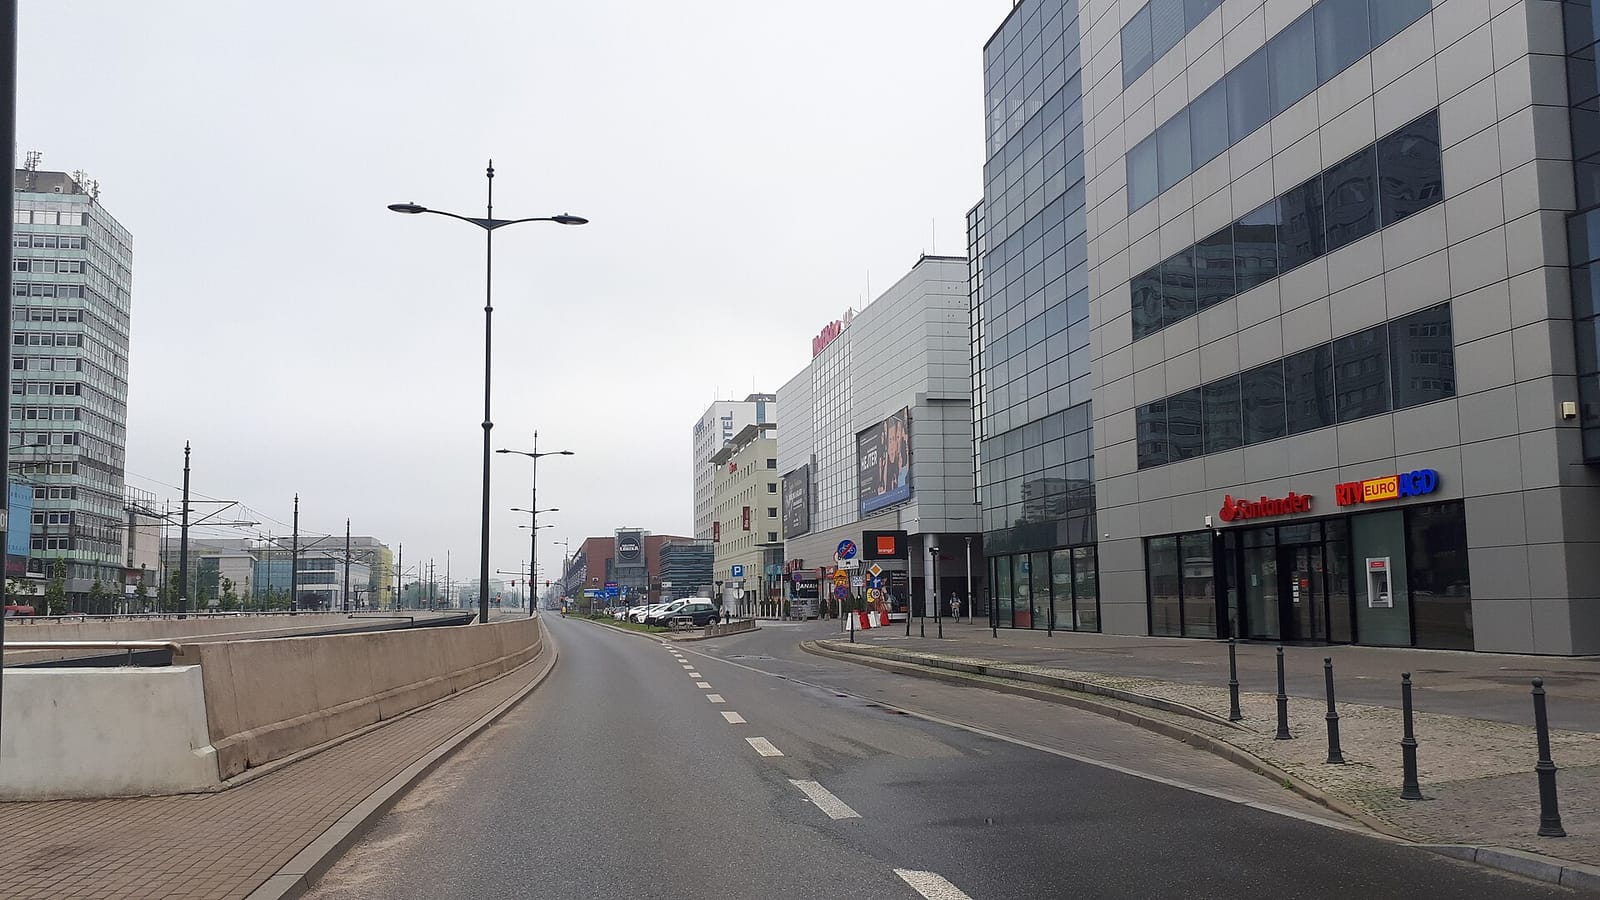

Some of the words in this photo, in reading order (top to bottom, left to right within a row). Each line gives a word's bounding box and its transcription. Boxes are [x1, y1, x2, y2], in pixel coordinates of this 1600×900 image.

[1335, 481, 1364, 507] RTV
[1364, 480, 1397, 497] EURO
[1398, 469, 1438, 497] AGD
[1234, 492, 1312, 519] Santander
[734, 566, 742, 576] P
